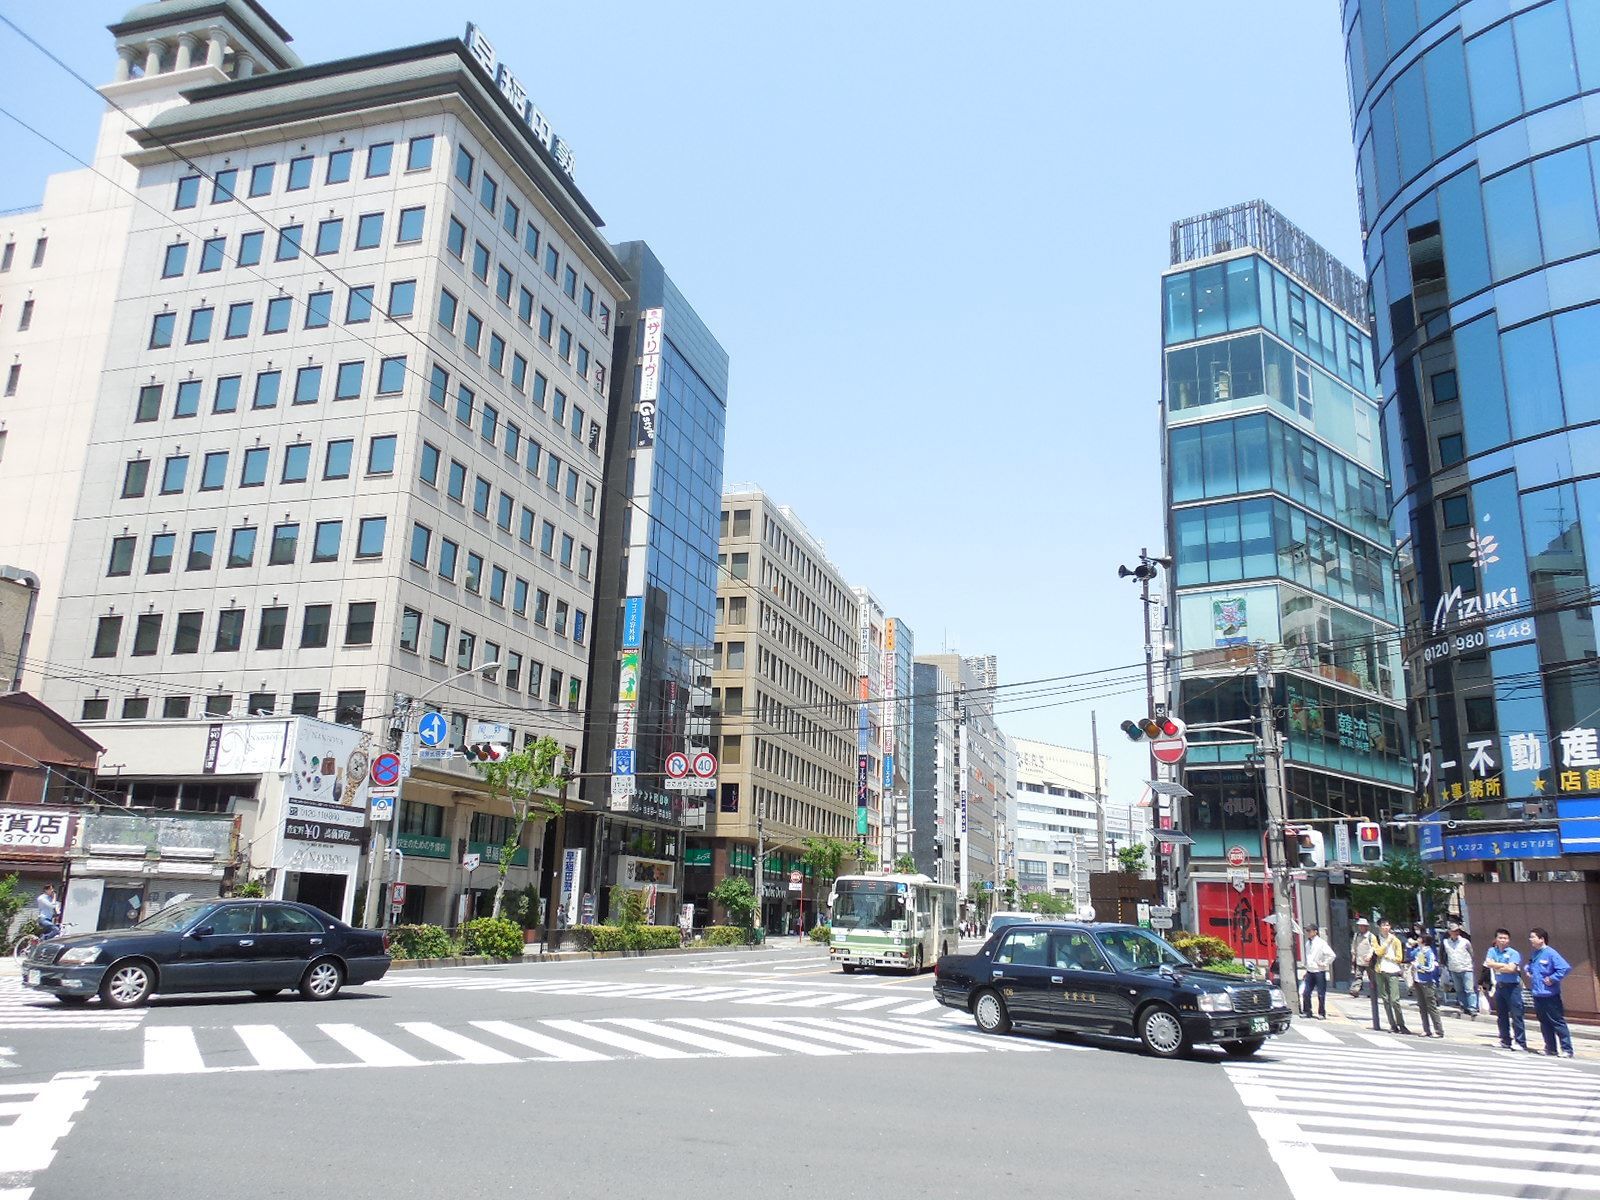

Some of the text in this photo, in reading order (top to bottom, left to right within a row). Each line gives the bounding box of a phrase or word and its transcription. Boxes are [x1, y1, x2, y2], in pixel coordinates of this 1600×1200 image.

[698, 760, 712, 772] 40
[1451, 778, 1502, 800] 事務所
